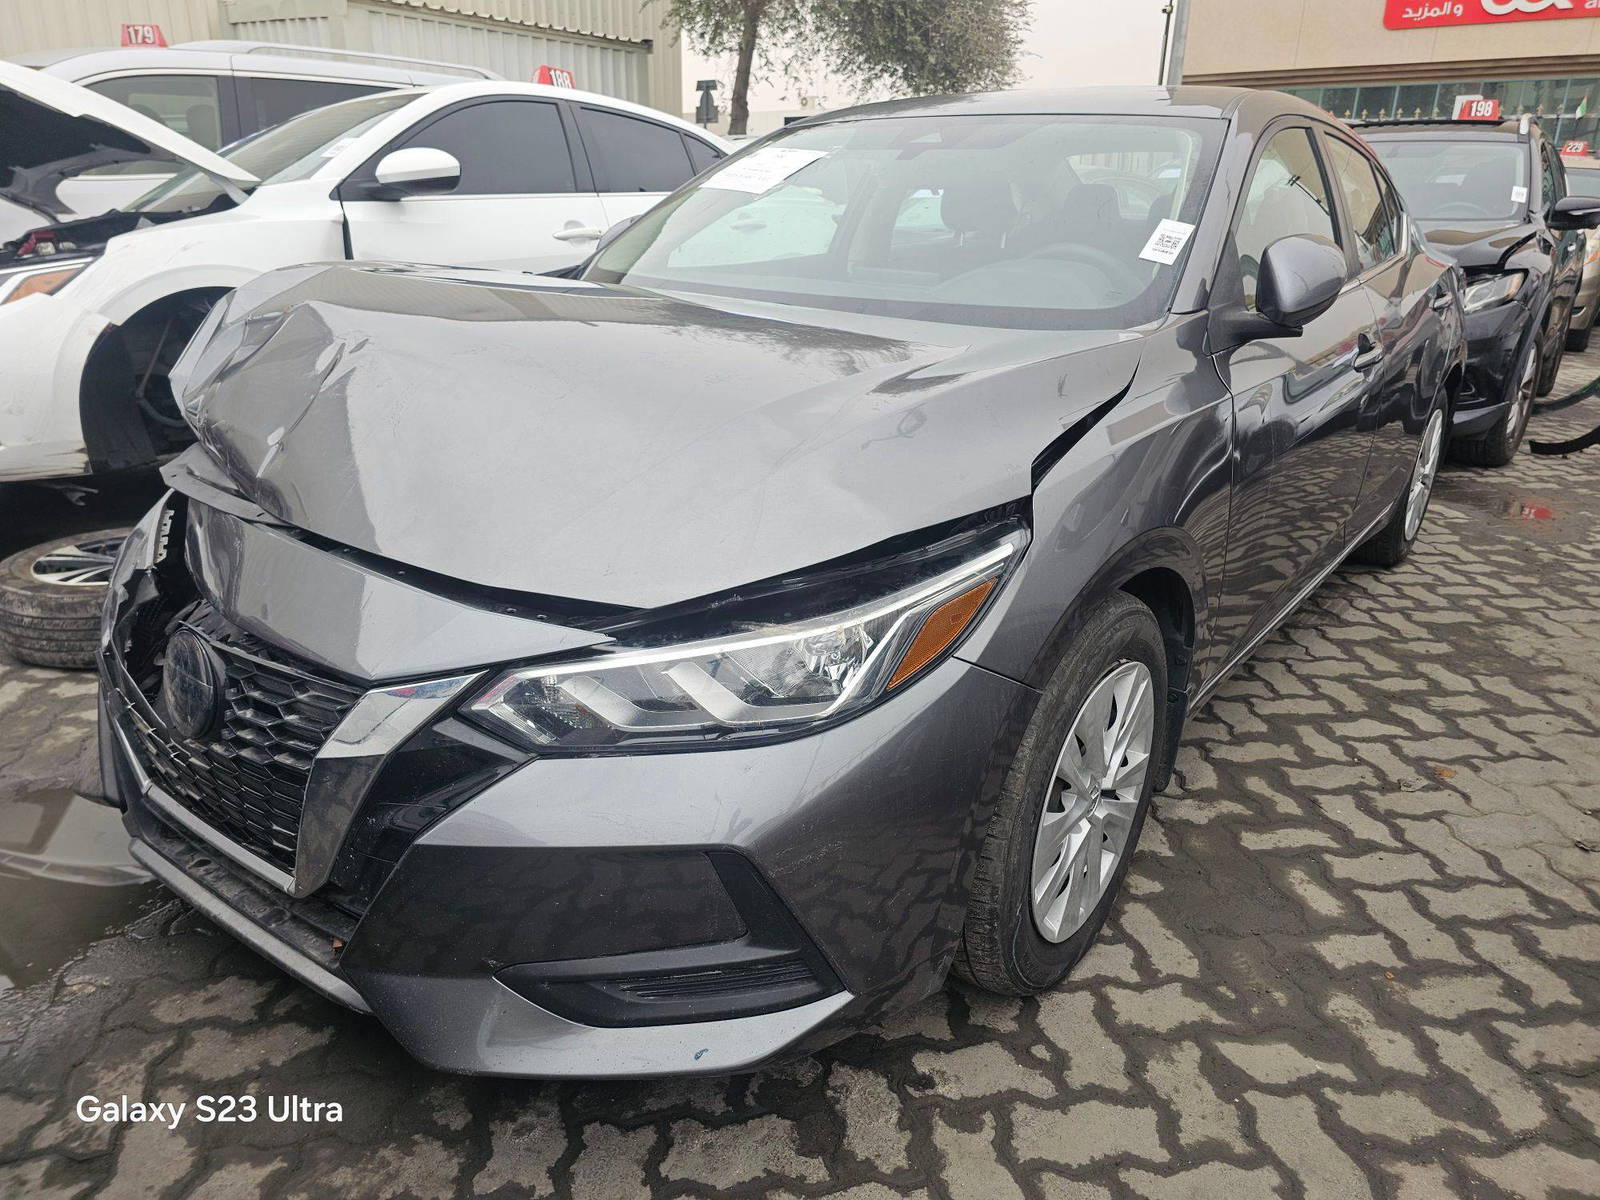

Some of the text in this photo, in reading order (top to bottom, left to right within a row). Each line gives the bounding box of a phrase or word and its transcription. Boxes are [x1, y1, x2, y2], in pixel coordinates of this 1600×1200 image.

[127, 25, 154, 44] 179
[549, 69, 573, 89] 188
[1470, 100, 1494, 117] 198
[1566, 142, 1584, 153] 229
